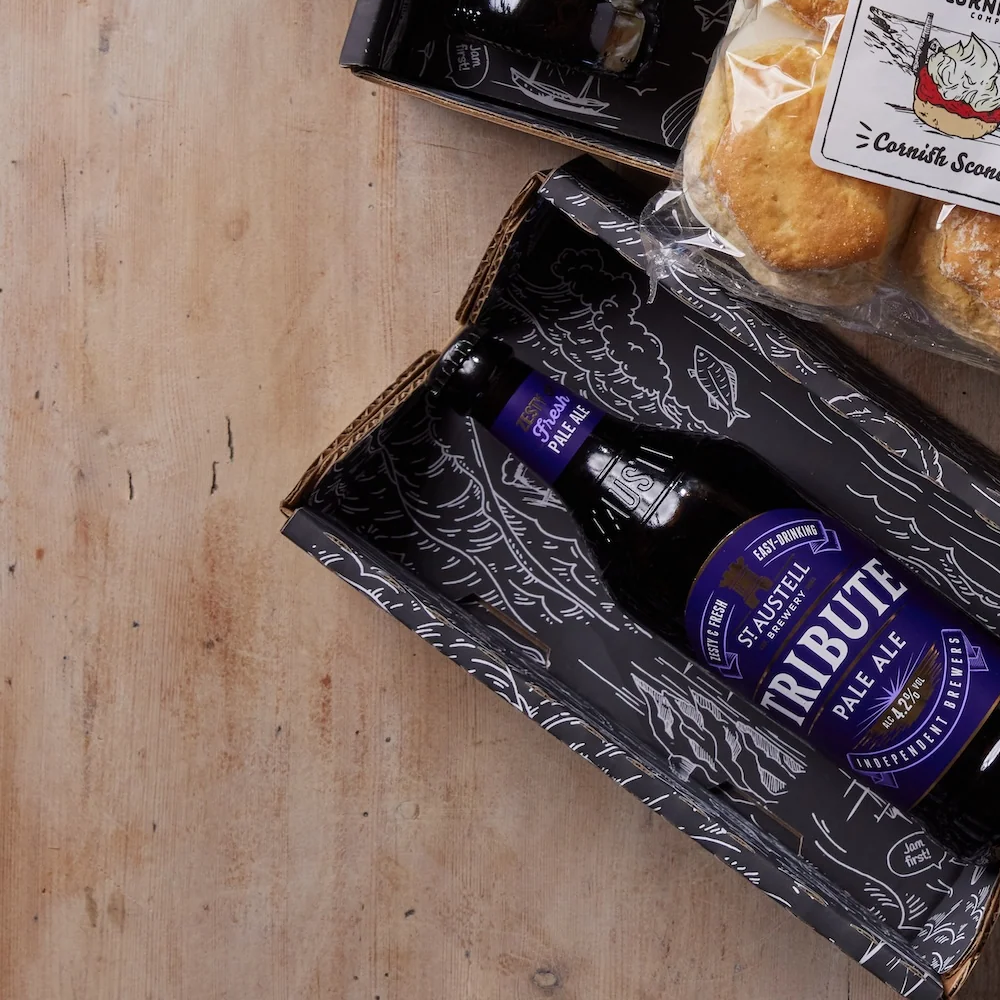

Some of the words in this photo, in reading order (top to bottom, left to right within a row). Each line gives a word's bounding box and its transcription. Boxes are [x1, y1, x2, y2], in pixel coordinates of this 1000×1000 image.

[874, 132, 948, 168] Cornish
[533, 396, 570, 443] Fresh
[548, 421, 576, 454] PALE
[569, 404, 590, 425] ALE
[752, 524, 818, 561] EASY-DRINKING
[708, 599, 728, 628] FRESH
[752, 562, 811, 634] AUSTELL
[767, 590, 807, 639] BREWERY
[707, 629, 719, 637] &
[707, 638, 721, 662] ZESTY
[760, 557, 908, 727] TRIBUTE
[832, 670, 875, 720] PALE
[872, 630, 906, 673] ALE
[856, 715, 948, 768] INDEPENDENT
[943, 637, 963, 710] BREWERS
[882, 715, 895, 729] ALC
[891, 687, 920, 720] 4.2%
[912, 677, 925, 690] VOL
[904, 839, 925, 854] Jam
[905, 848, 931, 867] first!
